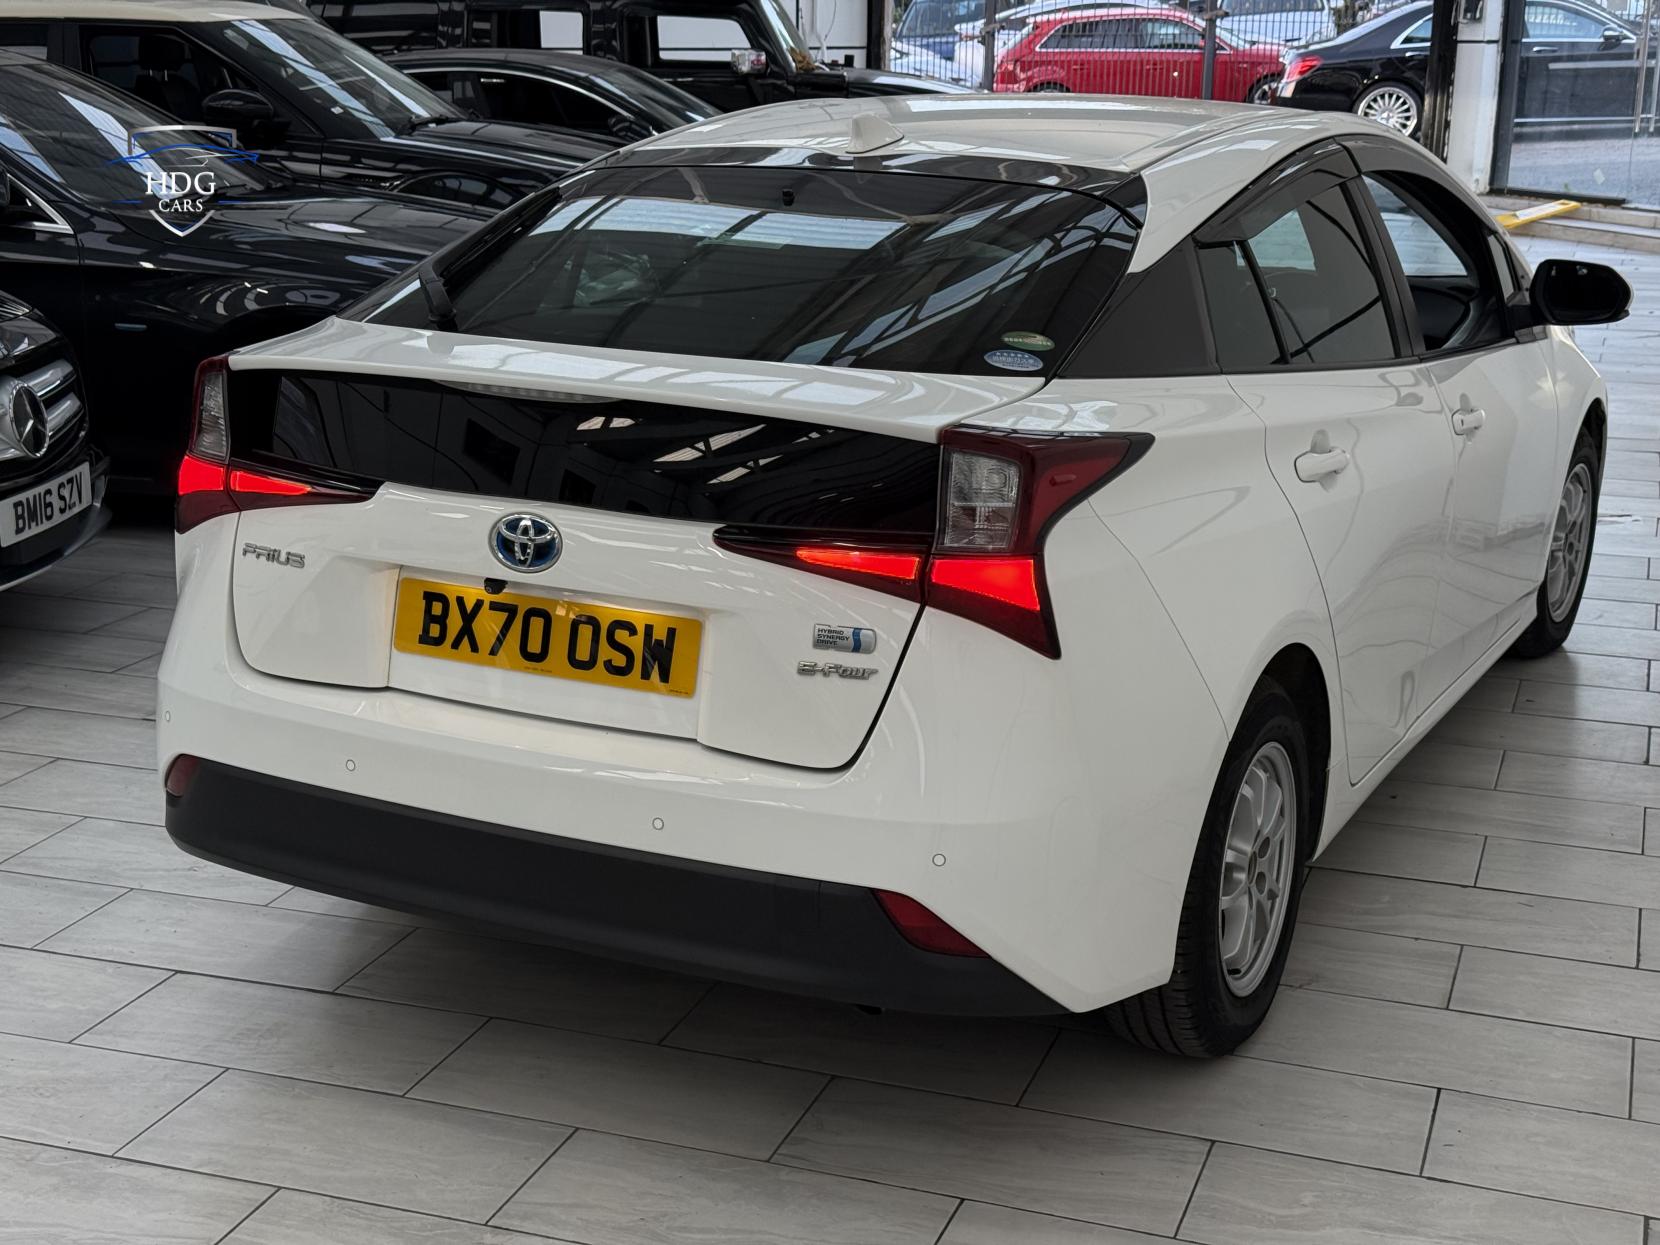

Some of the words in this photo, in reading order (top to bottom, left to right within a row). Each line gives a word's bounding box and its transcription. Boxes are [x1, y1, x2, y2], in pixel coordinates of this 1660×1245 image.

[13, 488, 54, 535] BM16
[57, 471, 83, 514] SZV
[242, 542, 305, 568] PRIUS
[418, 590, 552, 663] BX70
[567, 614, 676, 684] OSW
[817, 627, 844, 636] HYBRID
[817, 633, 850, 641] SYNERGY
